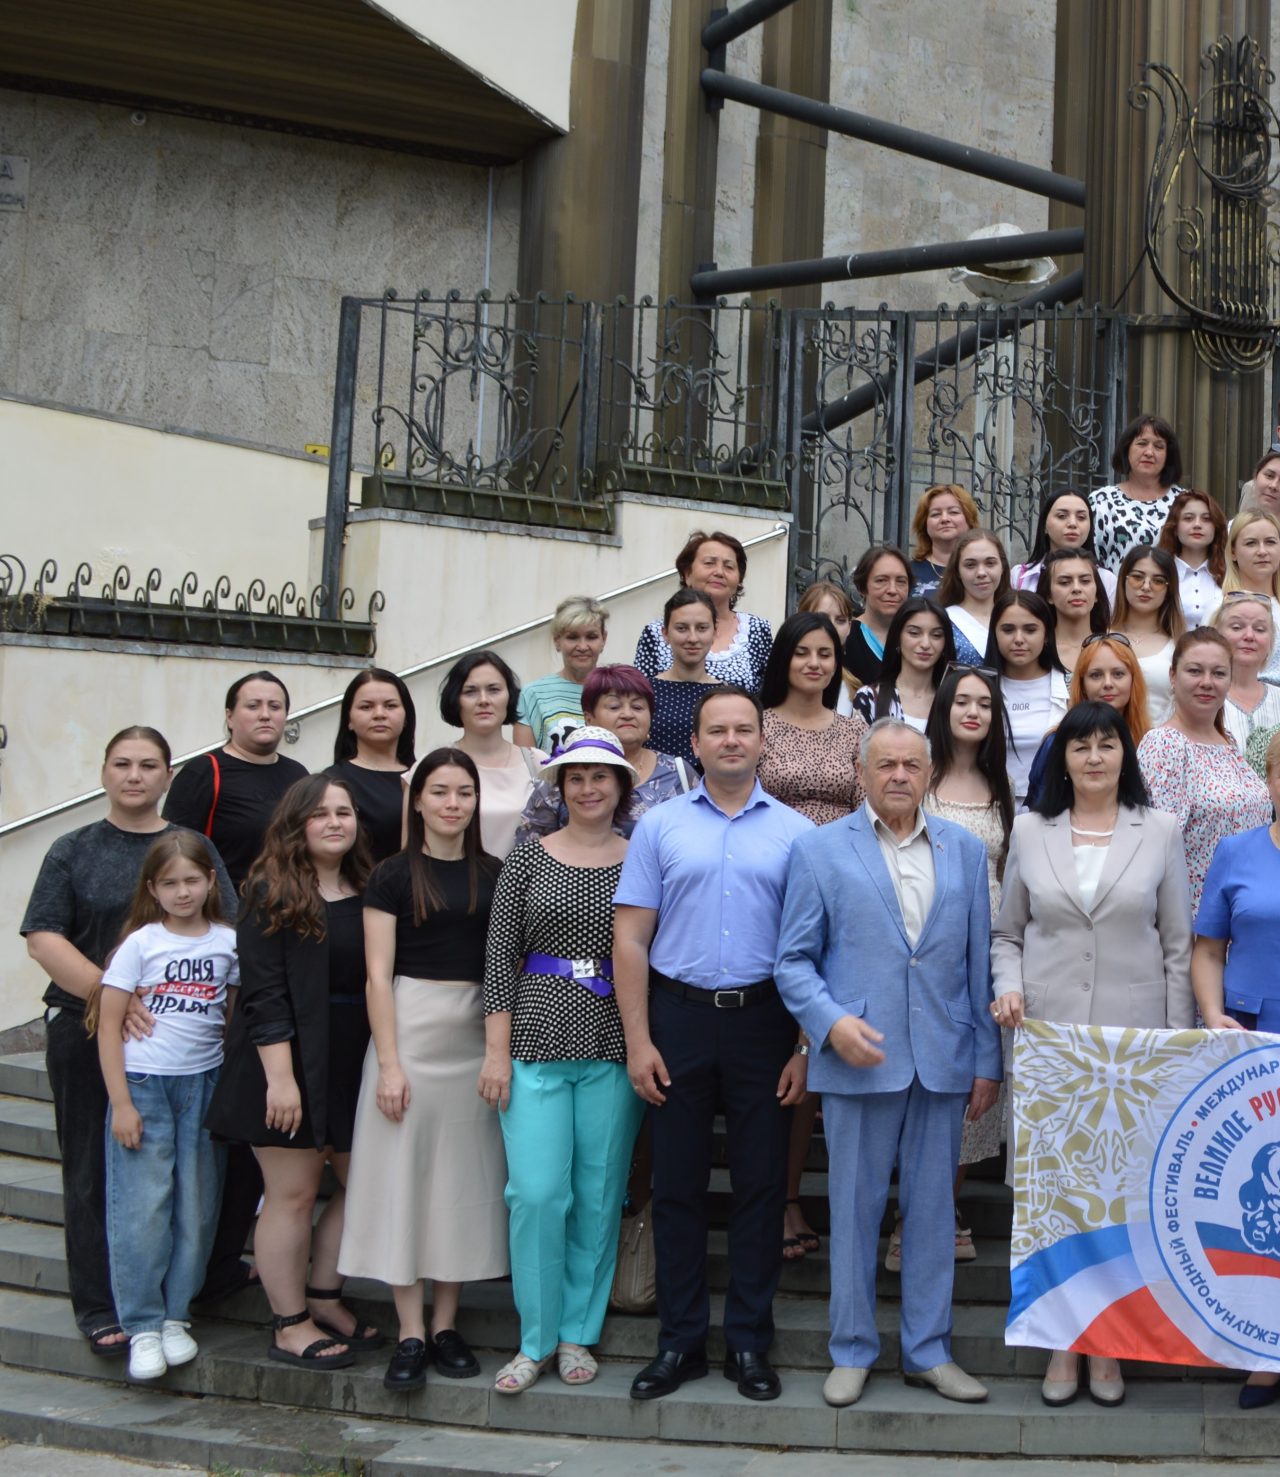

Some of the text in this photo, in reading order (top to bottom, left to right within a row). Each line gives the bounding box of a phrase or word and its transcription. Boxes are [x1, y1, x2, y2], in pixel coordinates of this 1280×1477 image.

[1012, 703, 1030, 711] DIOR
[165, 958, 214, 983] СОНЯ
[1165, 1130, 1195, 1232] ФЕСТИВАЛЬ
[1194, 1110, 1252, 1200] ВЕЛИКОЕ
